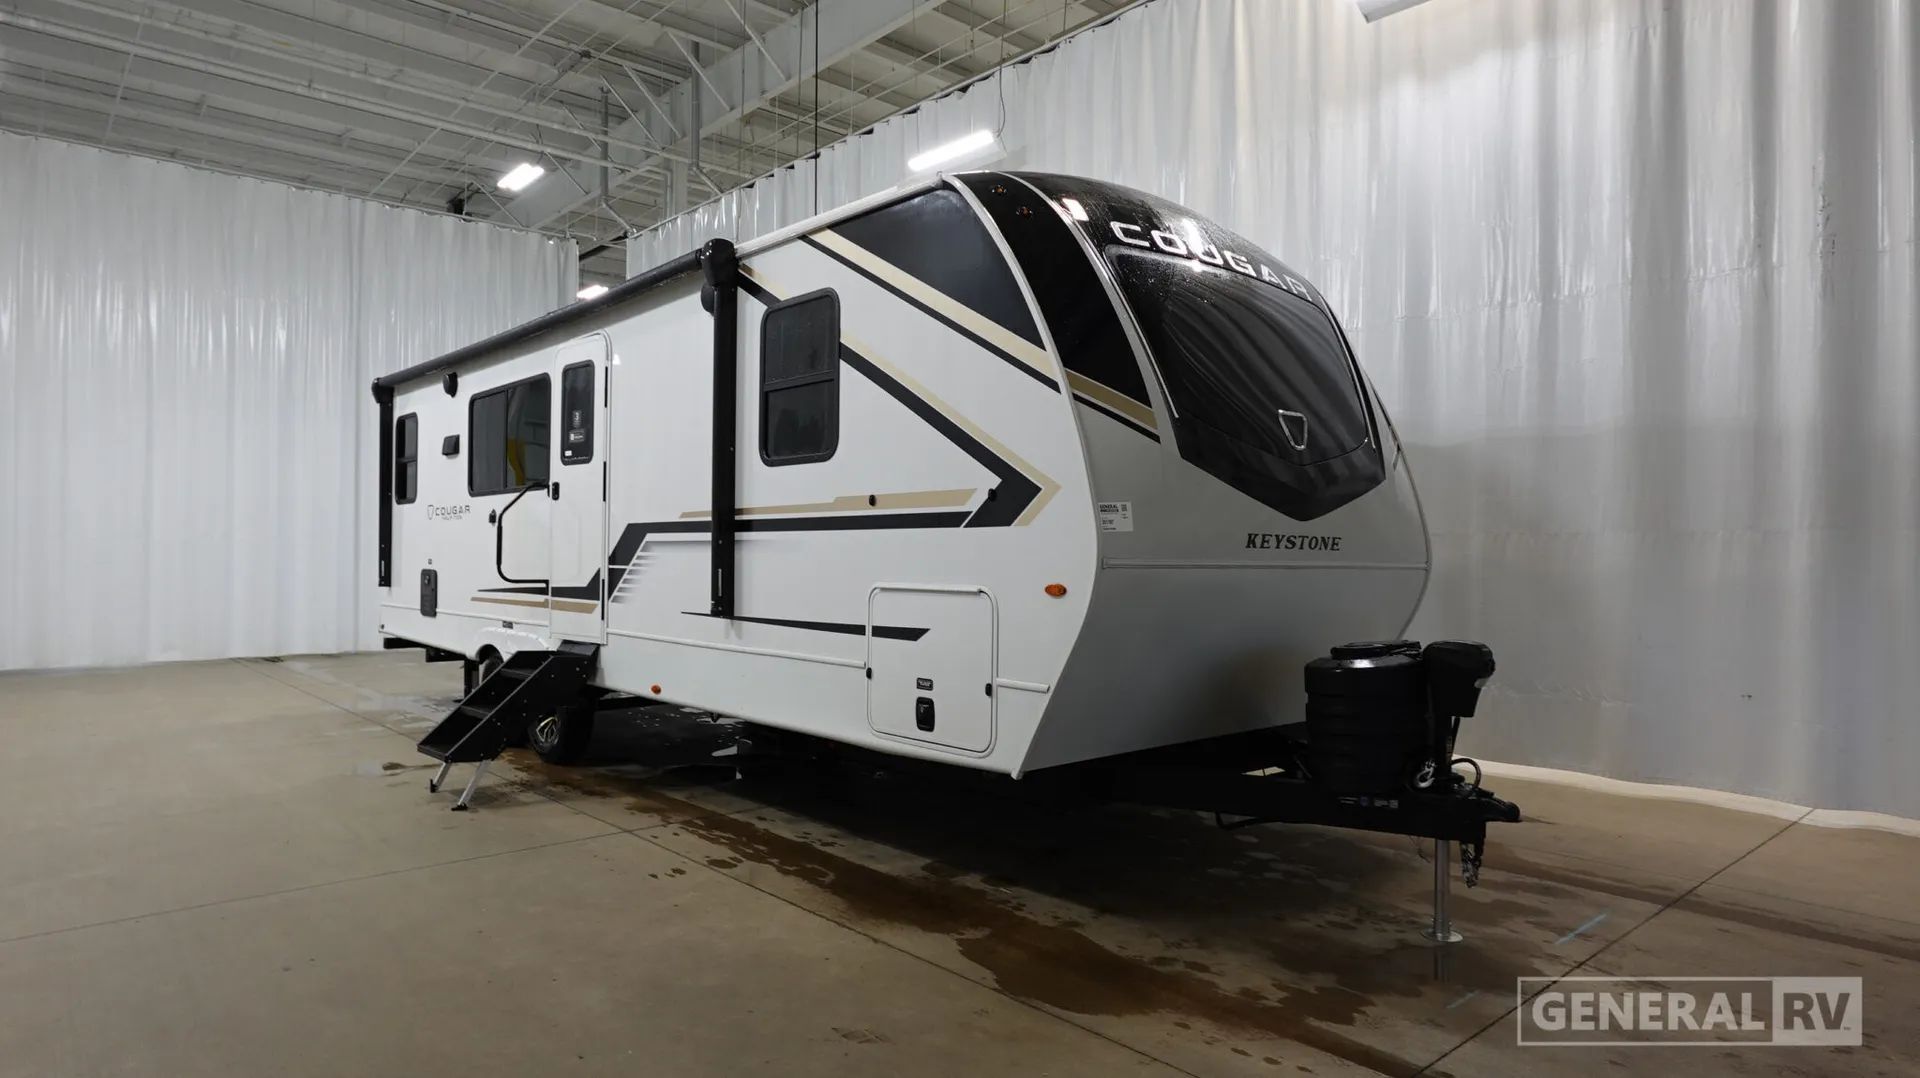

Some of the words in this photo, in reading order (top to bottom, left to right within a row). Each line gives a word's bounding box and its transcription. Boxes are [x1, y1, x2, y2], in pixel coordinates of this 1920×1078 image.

[1110, 220, 1312, 301] COUGAR
[435, 505, 471, 517] COUGAR
[1245, 533, 1342, 551] KEYSTONE
